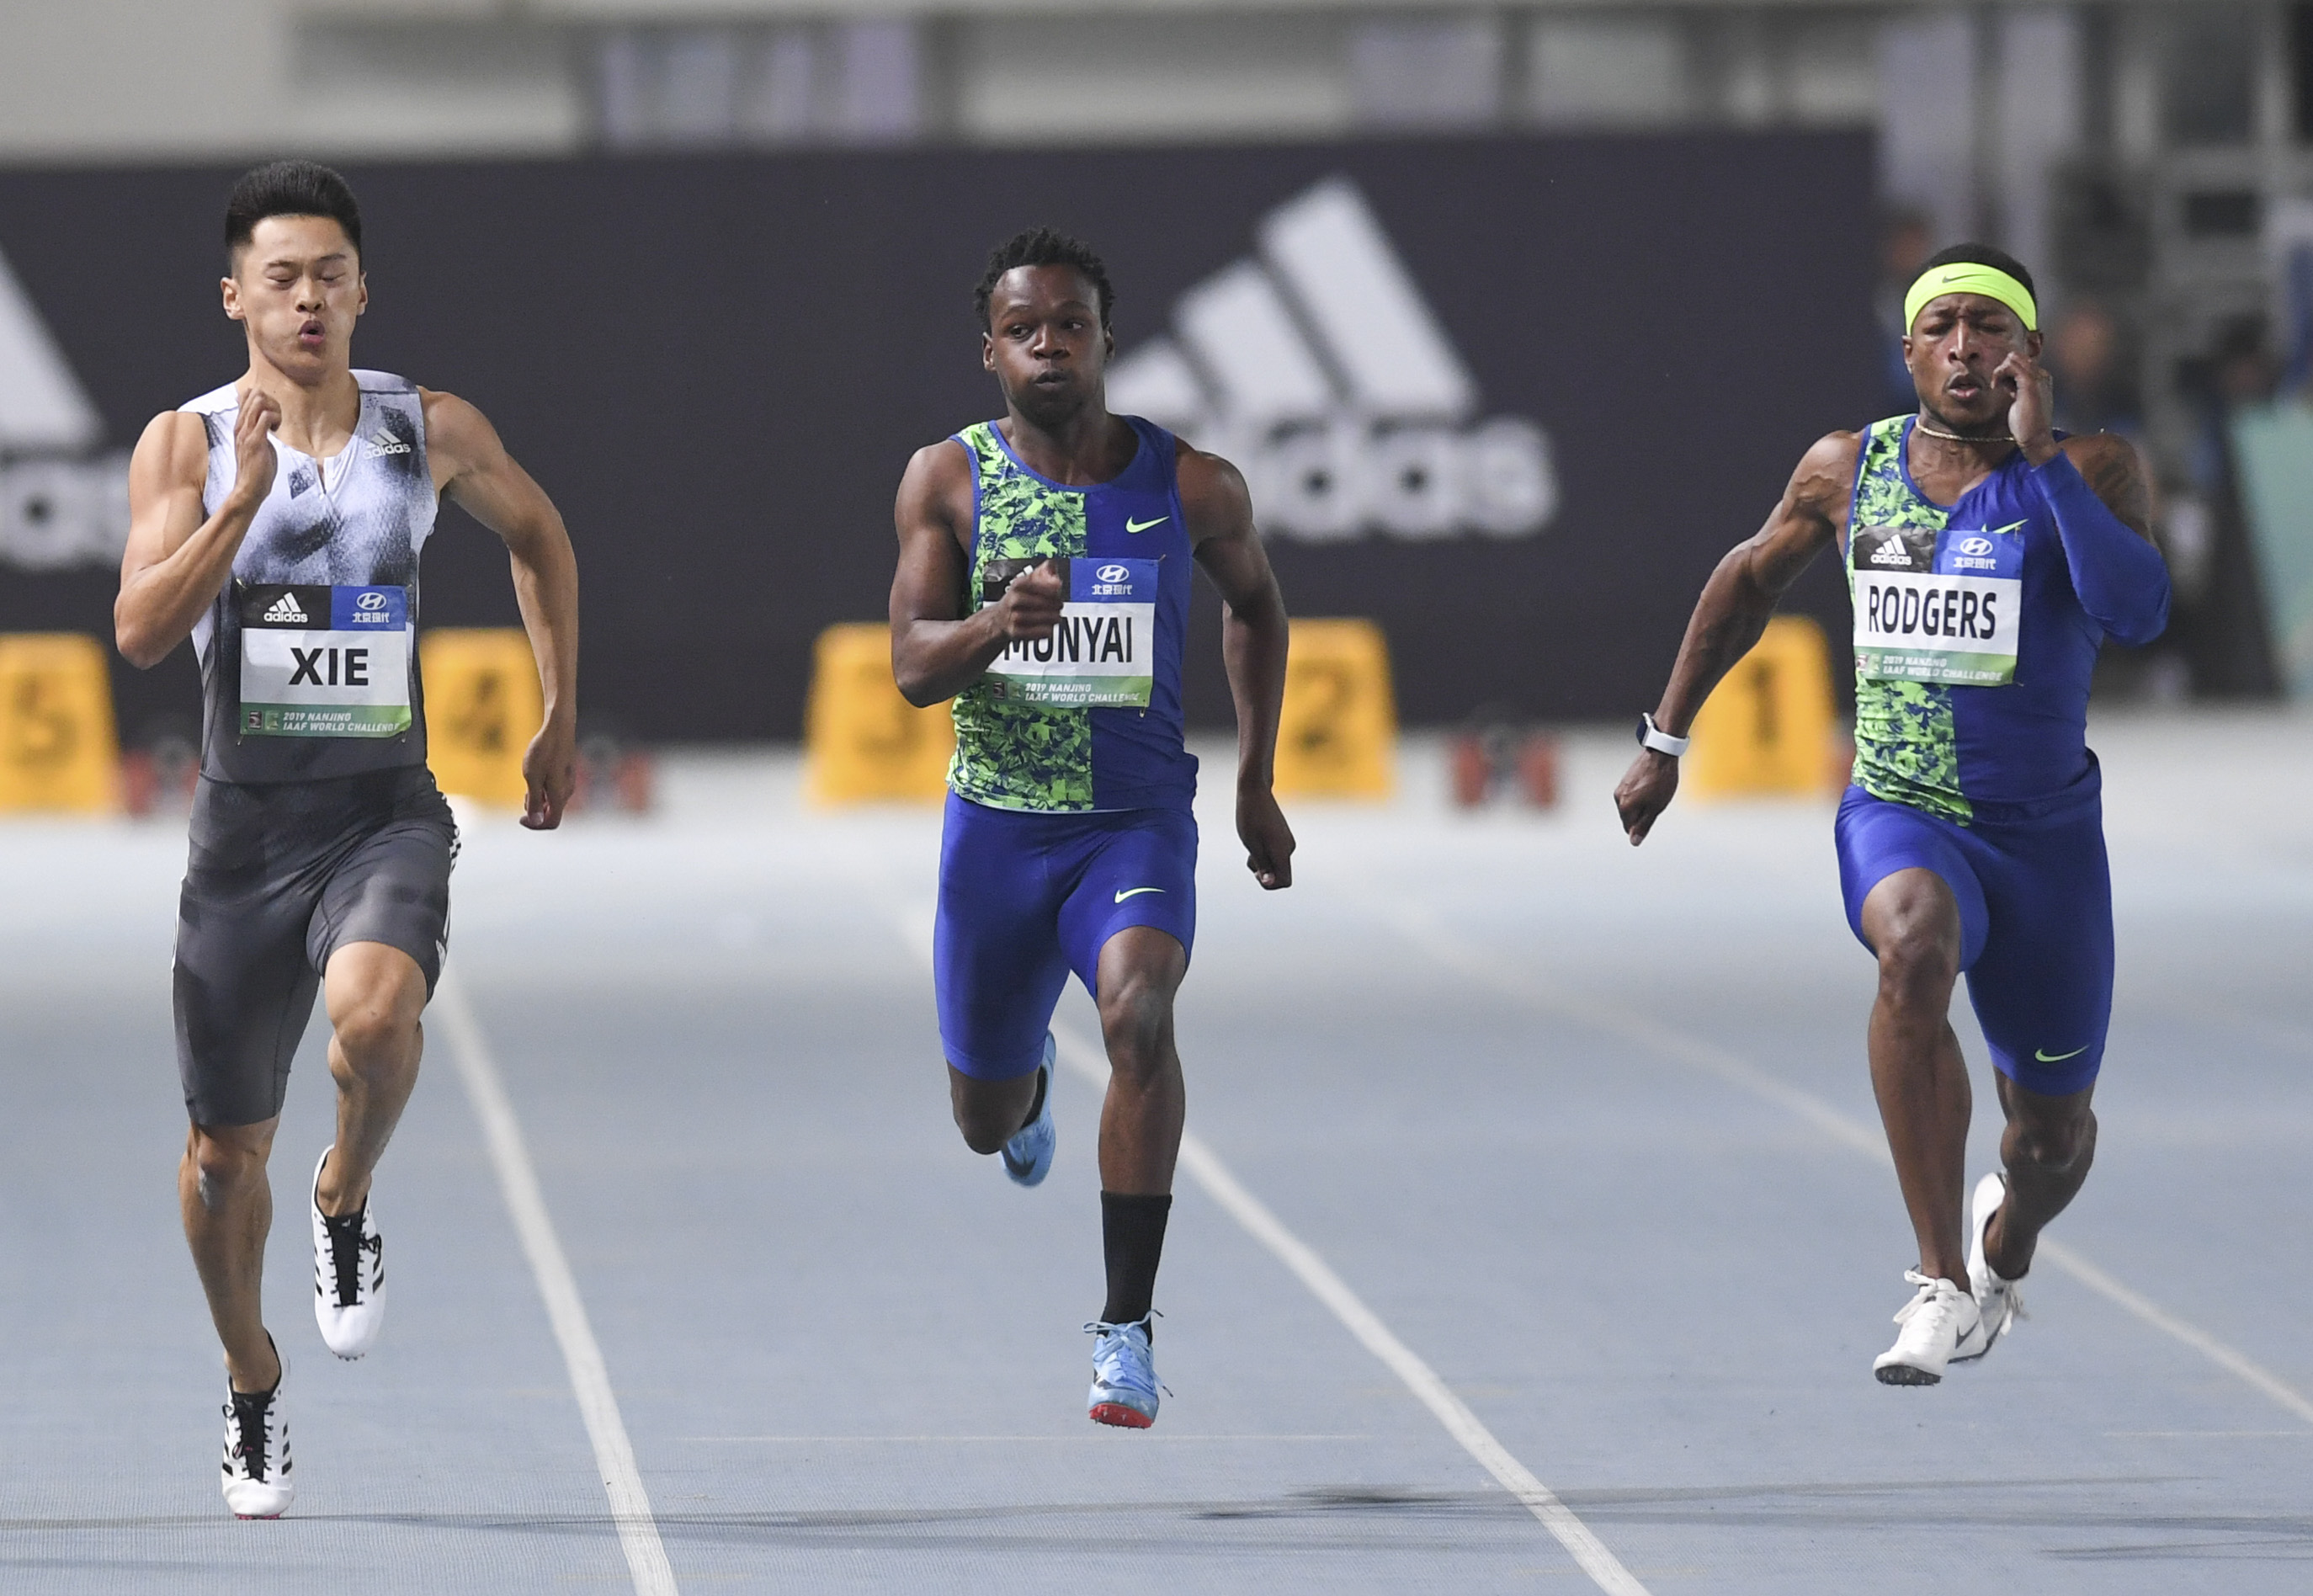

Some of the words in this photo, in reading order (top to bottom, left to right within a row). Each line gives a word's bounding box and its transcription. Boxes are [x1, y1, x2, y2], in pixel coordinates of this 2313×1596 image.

[363, 443, 412, 460] adidas
[1870, 554, 1912, 566] adidas
[1092, 584, 1133, 595] 北京现代
[263, 611, 309, 623] adidas
[352, 612, 390, 623] 北京现代
[1869, 585, 1997, 640] RODGERS
[288, 647, 369, 686] XIE
[1025, 683, 1047, 692] 2019
[1049, 683, 1092, 692] NANJING
[1025, 693, 1049, 701] IAAF
[1051, 693, 1087, 702] WORLD
[283, 712, 306, 721] 2019
[307, 712, 352, 721] NANJING
[283, 721, 307, 731] IAAF
[310, 722, 345, 732] WORLD
